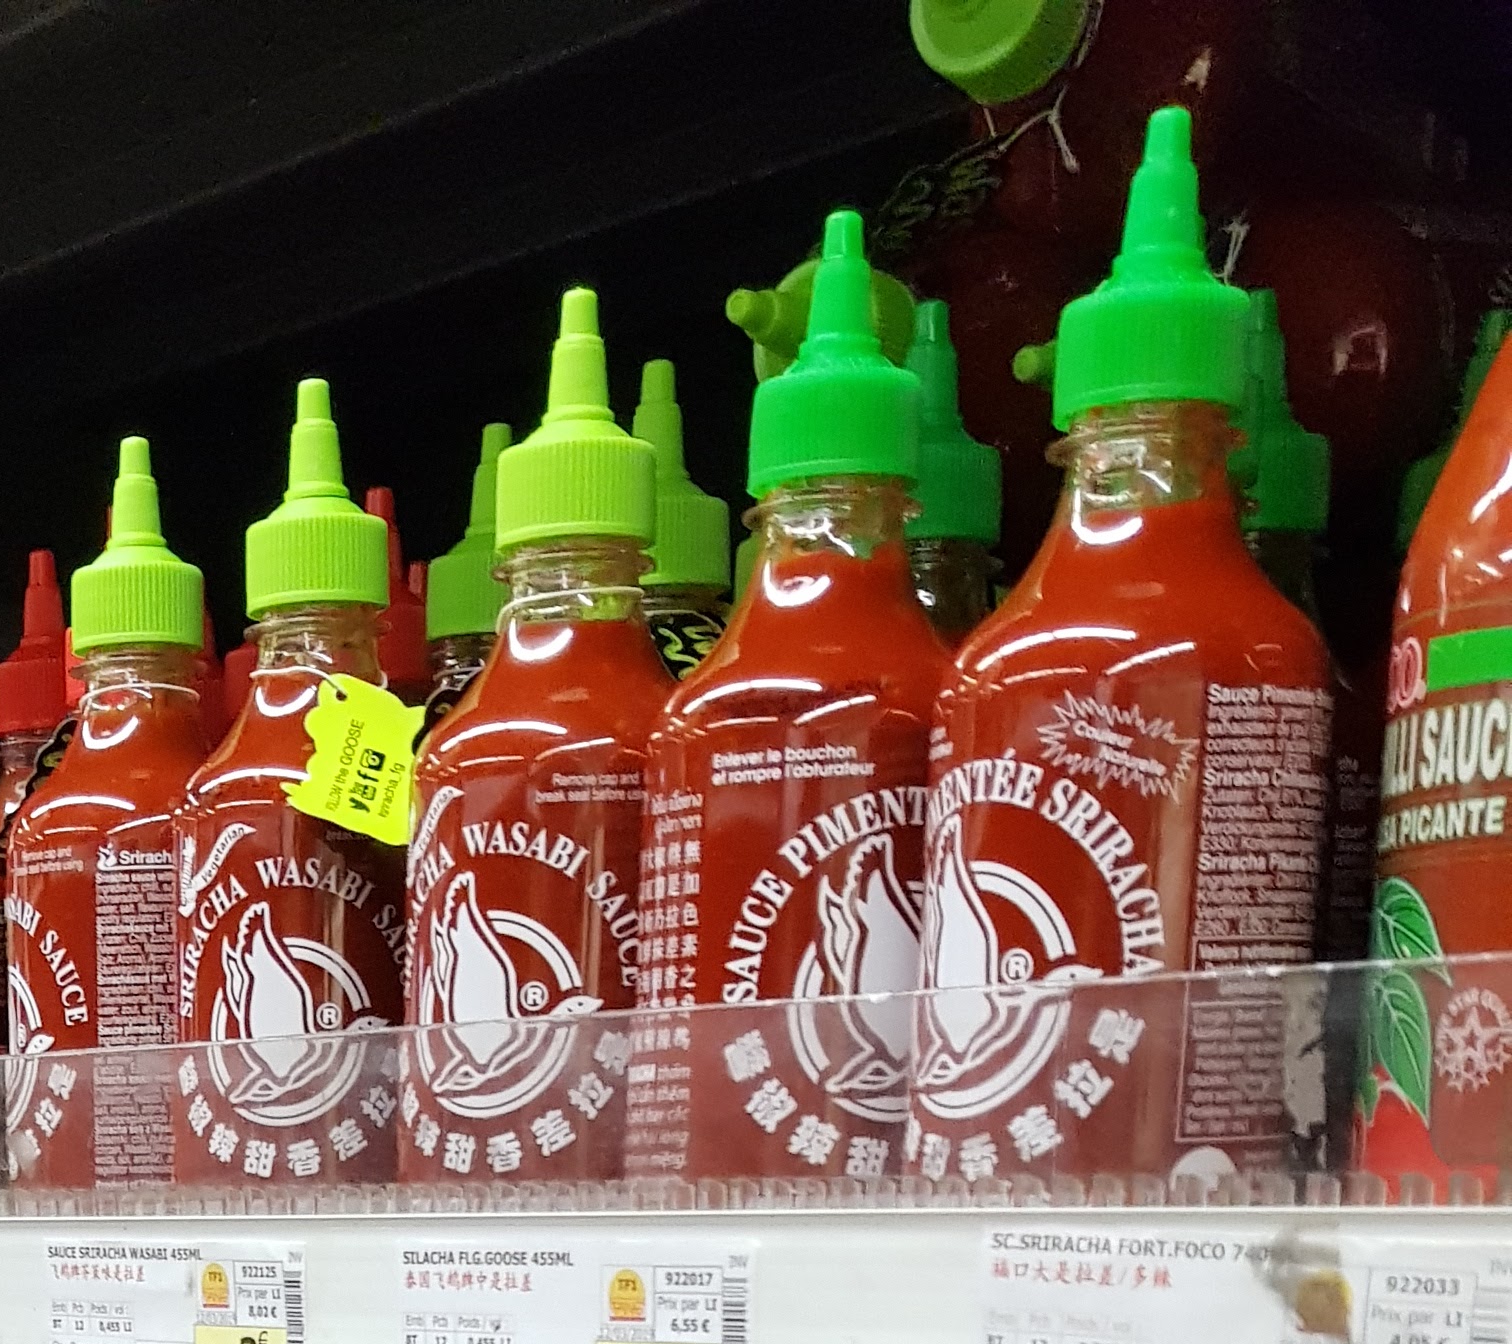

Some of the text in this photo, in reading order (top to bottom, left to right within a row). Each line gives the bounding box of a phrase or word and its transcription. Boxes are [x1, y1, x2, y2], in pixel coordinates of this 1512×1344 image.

[334, 719, 365, 784] the GOOSE
[712, 744, 857, 770] Enlever le bouchon
[618, 772, 640, 787] and
[727, 767, 782, 787] rompre
[1399, 797, 1504, 844] PICANTE
[1040, 778, 1167, 977] SRIRACHA
[462, 821, 590, 879] WASABI
[586, 870, 643, 988] SAUCE
[178, 874, 249, 1020] SRIRACHA
[254, 856, 377, 910] WASABI
[722, 869, 793, 1003] SAUCE
[40, 930, 88, 1028] SAUCE
[48, 1246, 202, 1261] SAUCE SRIRACHA WASABI 455ML
[403, 1250, 455, 1266] SILACHA
[531, 1252, 574, 1267] 455ML
[1119, 1237, 1226, 1261] FORT.FOCO
[242, 1266, 277, 1279] 922125
[664, 1272, 713, 1287] 922017
[1387, 1274, 1461, 1297] 922033
[248, 1305, 269, 1318] 8,02
[657, 1297, 680, 1312] Prix
[682, 1299, 700, 1314] par
[1371, 1305, 1464, 1328] Prix par LI
[670, 1319, 698, 1335] 6,55
